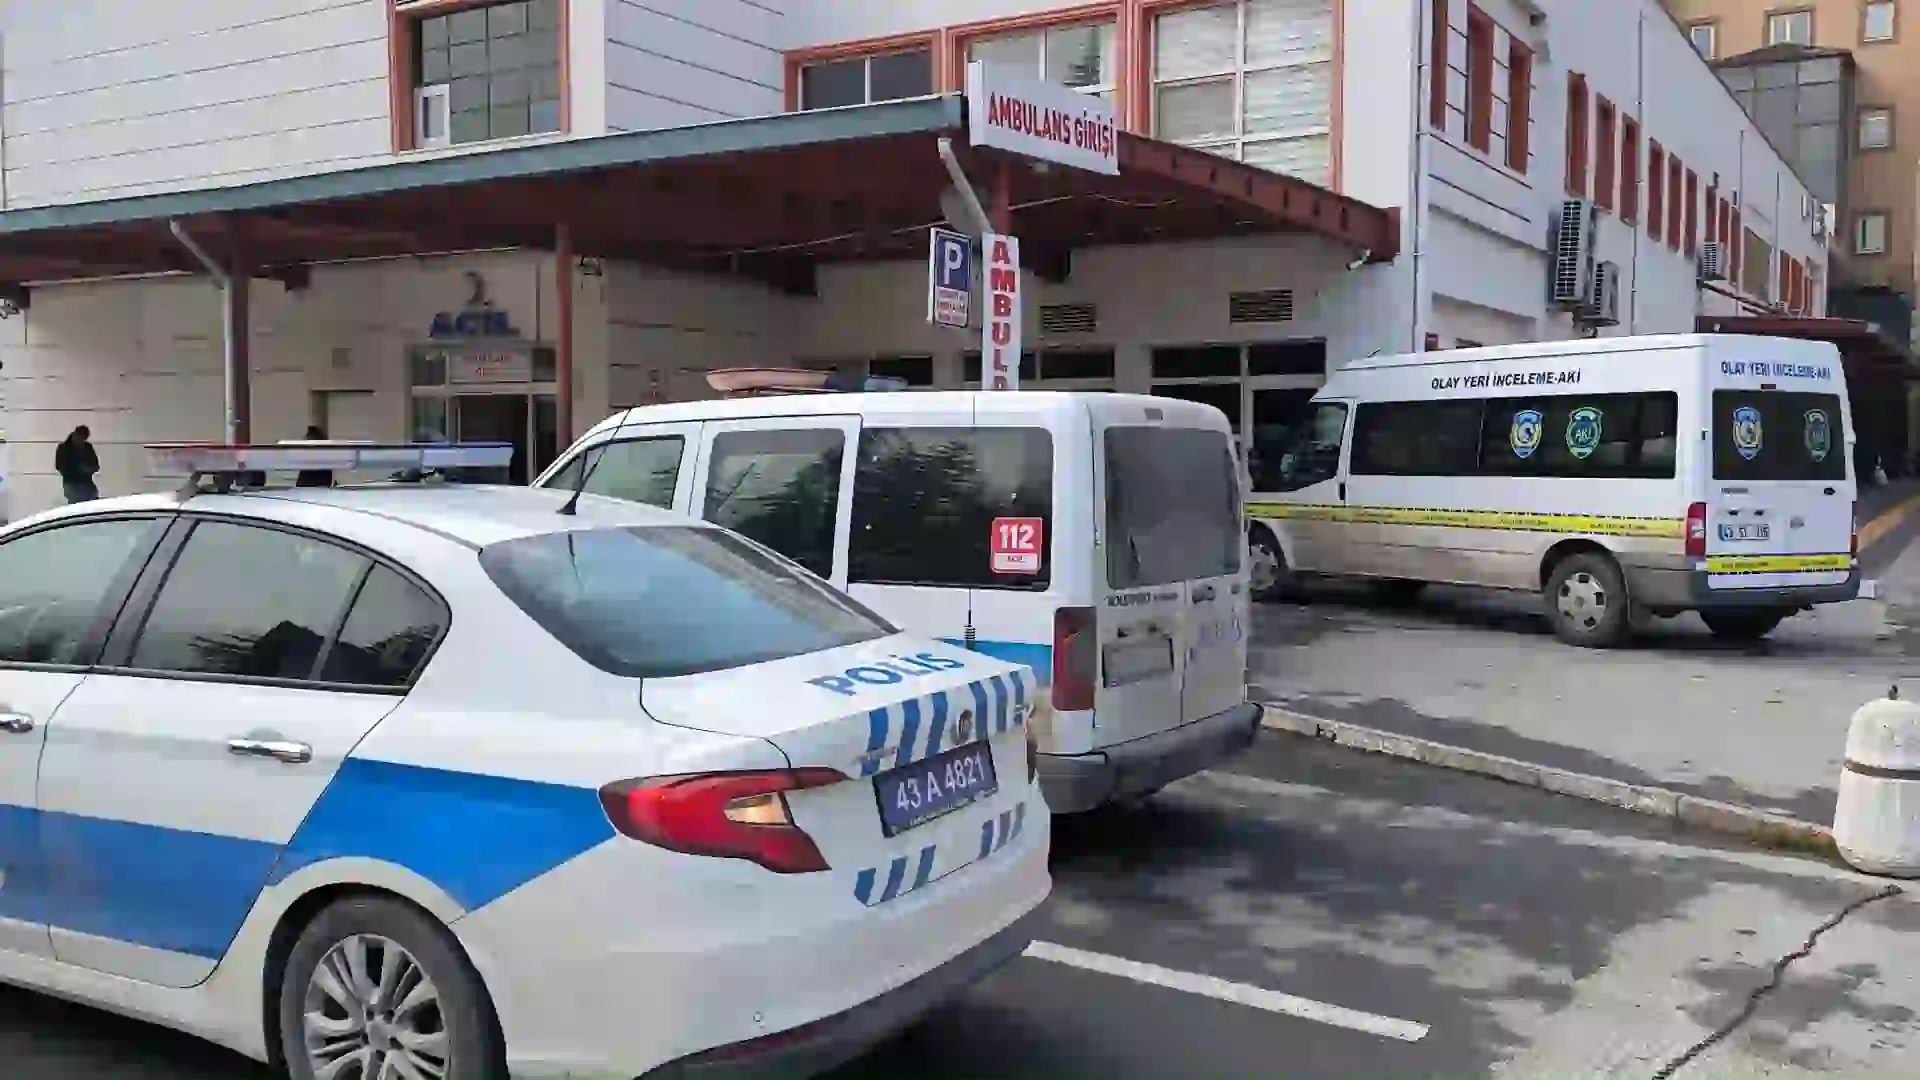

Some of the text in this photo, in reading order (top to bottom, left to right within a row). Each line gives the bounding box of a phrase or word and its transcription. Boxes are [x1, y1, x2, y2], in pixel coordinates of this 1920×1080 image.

[988, 91, 1114, 160] AMBULANS GİRİŞİ
[943, 241, 964, 285] P
[1431, 376, 1460, 390] OLAY
[1000, 523, 1035, 549] 112
[804, 652, 965, 697] POLİS
[896, 750, 986, 812] 43 A 4821
